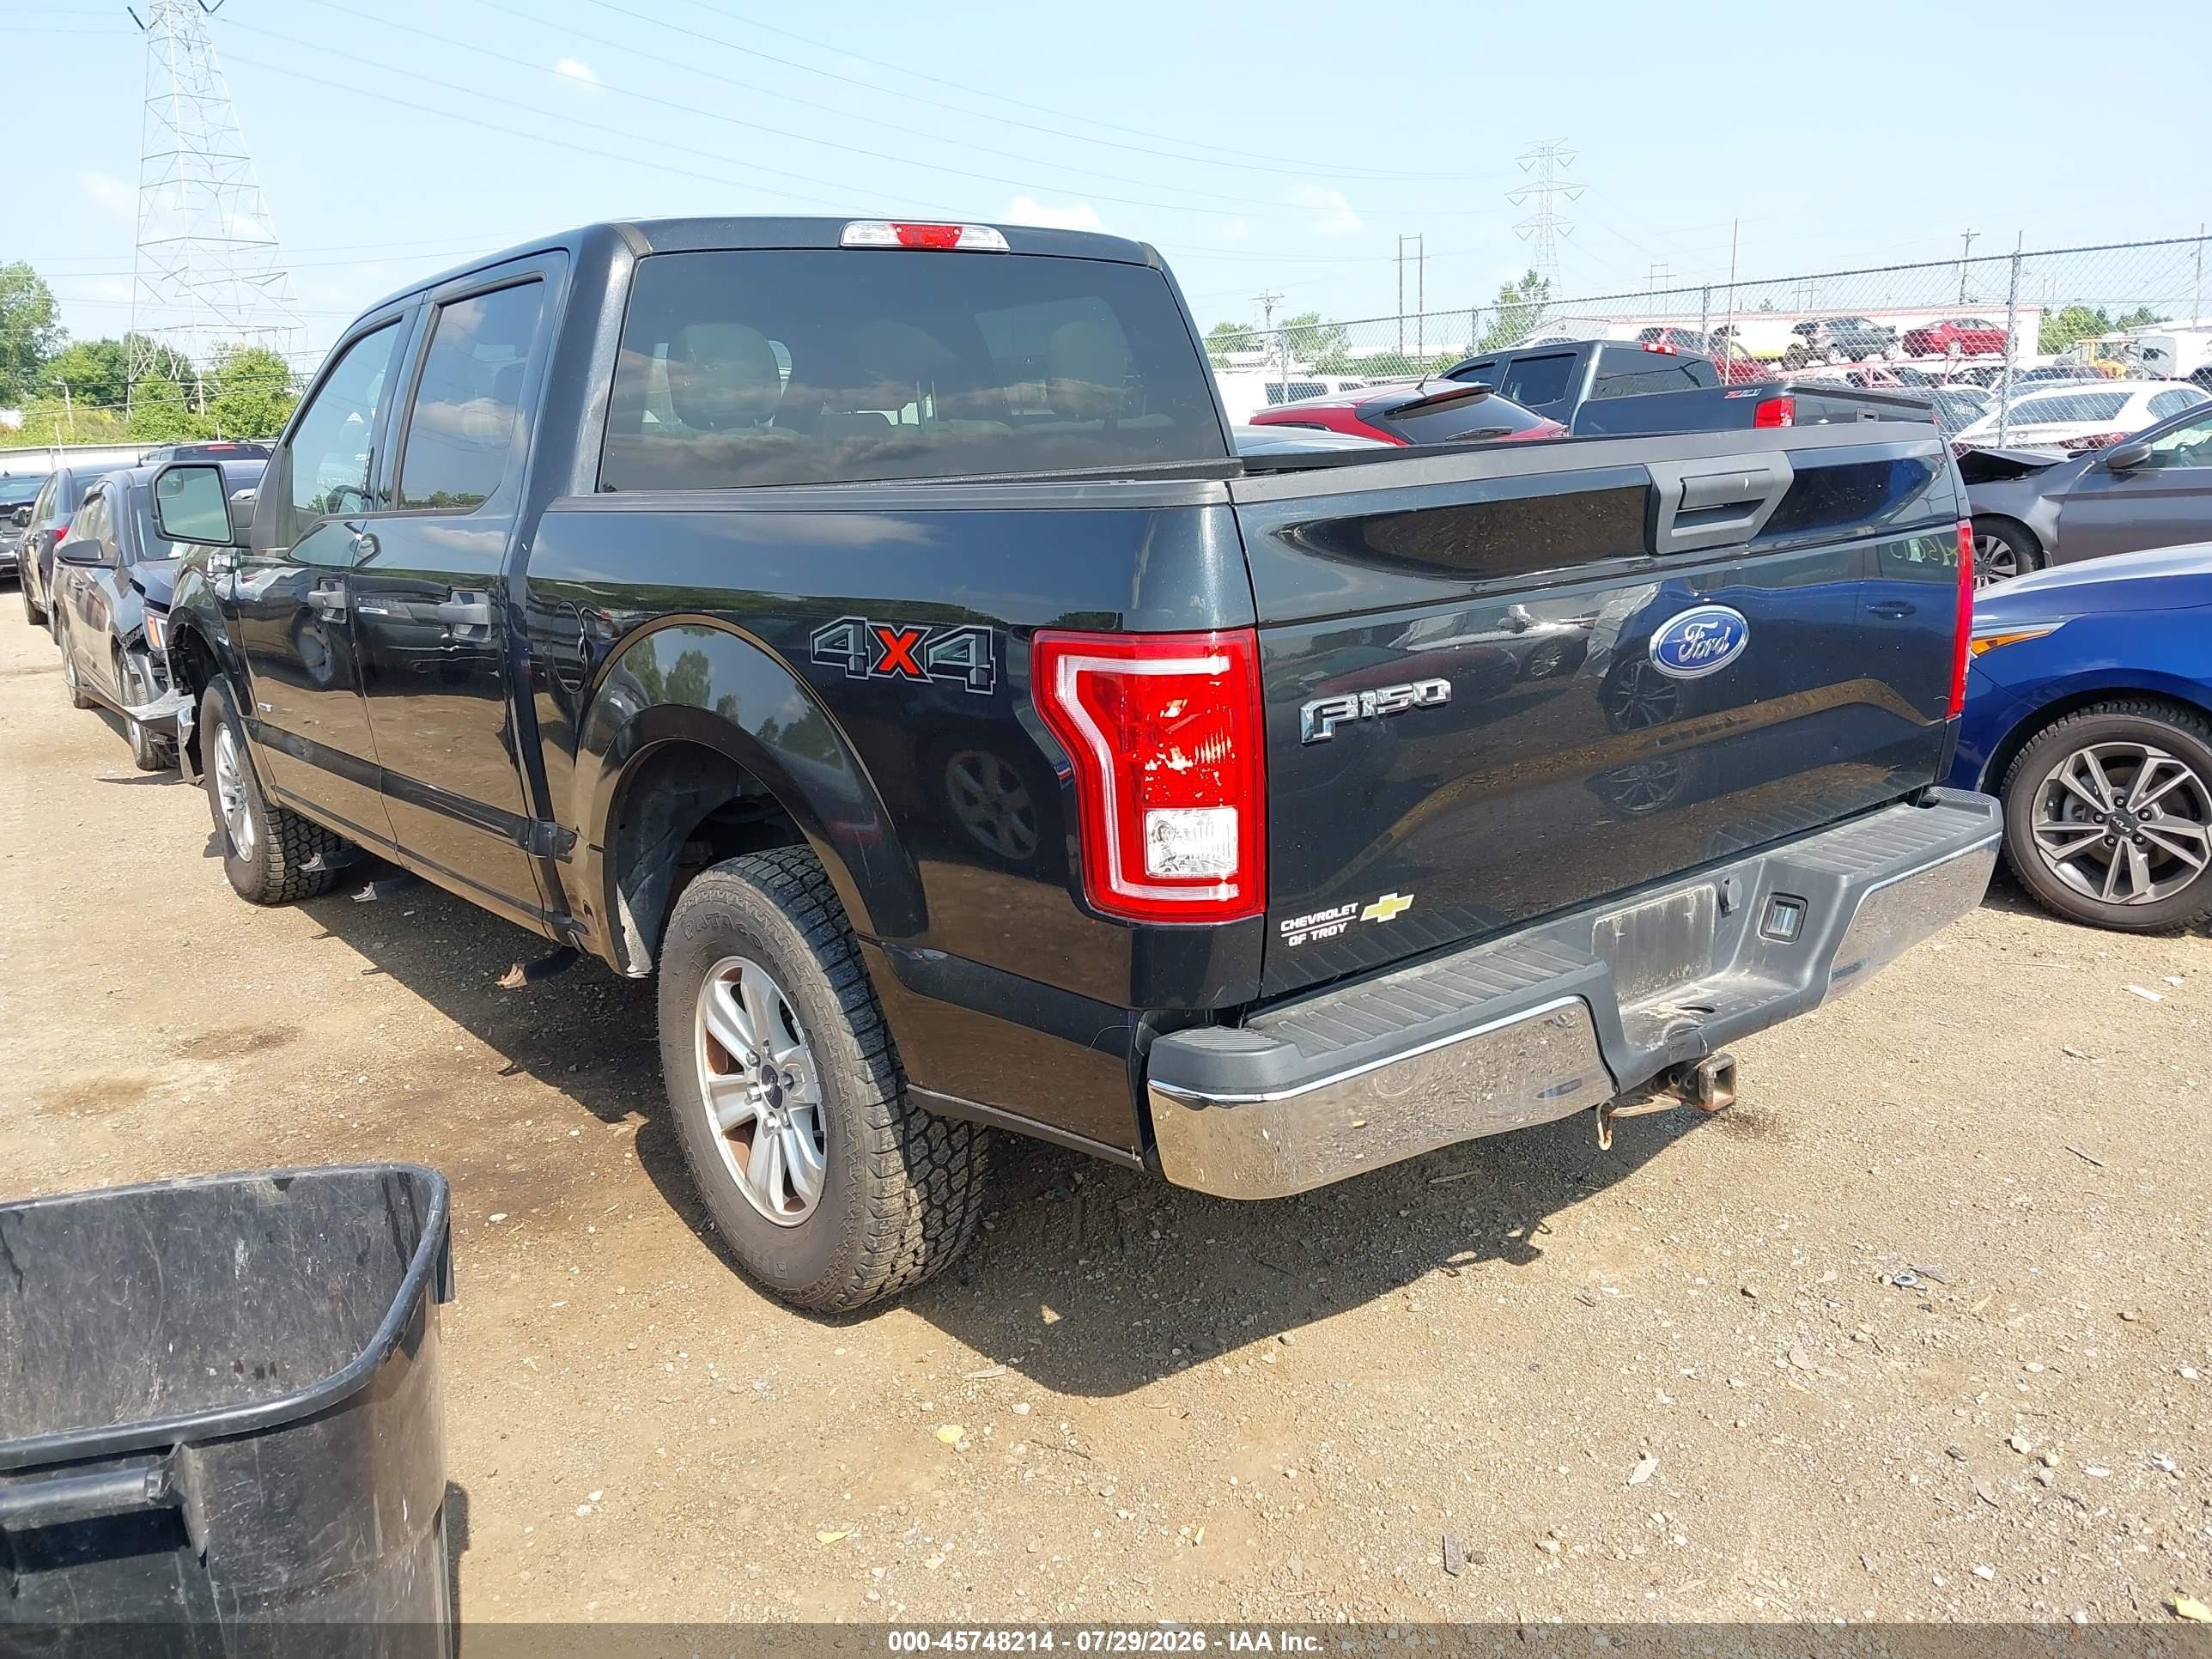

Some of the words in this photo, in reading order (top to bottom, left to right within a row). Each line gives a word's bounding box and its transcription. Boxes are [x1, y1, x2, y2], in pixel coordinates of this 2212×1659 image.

[1678, 620, 1731, 663] Ford
[1280, 902, 1358, 933] CHEVROLET
[1288, 933, 1307, 947] OF
[1310, 922, 1347, 941] TROY
